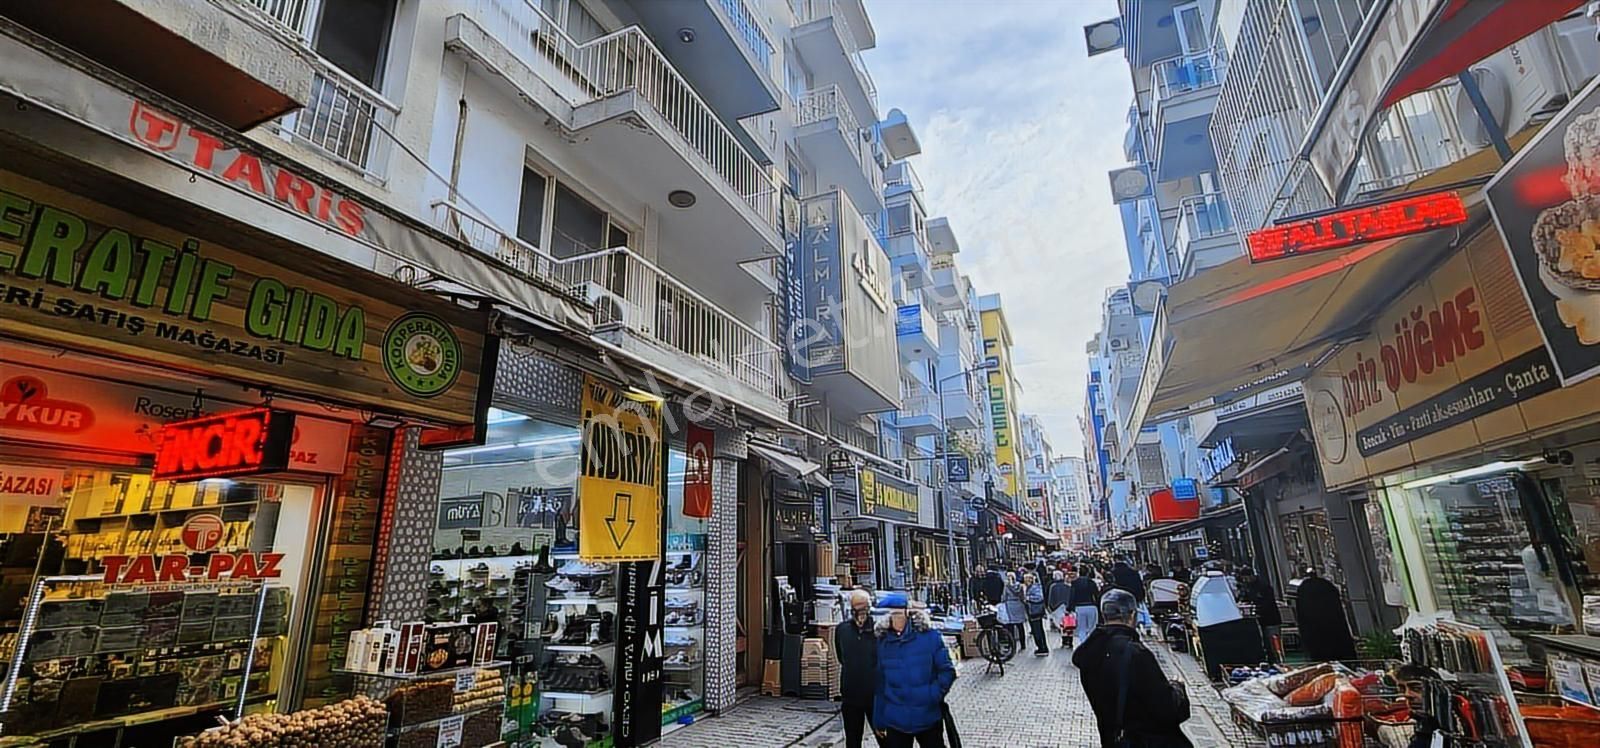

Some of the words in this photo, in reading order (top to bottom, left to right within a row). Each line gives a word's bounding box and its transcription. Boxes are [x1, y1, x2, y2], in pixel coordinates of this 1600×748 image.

[54, 297, 145, 334] SATIŞ
[156, 320, 286, 366] MAĞAZASI
[246, 277, 366, 361] GIDA
[1341, 352, 1382, 418] AZİZ
[1380, 286, 1485, 394] DÜĞME
[1504, 363, 1550, 399] Çanta
[100, 552, 286, 586] TAR-PAZ
